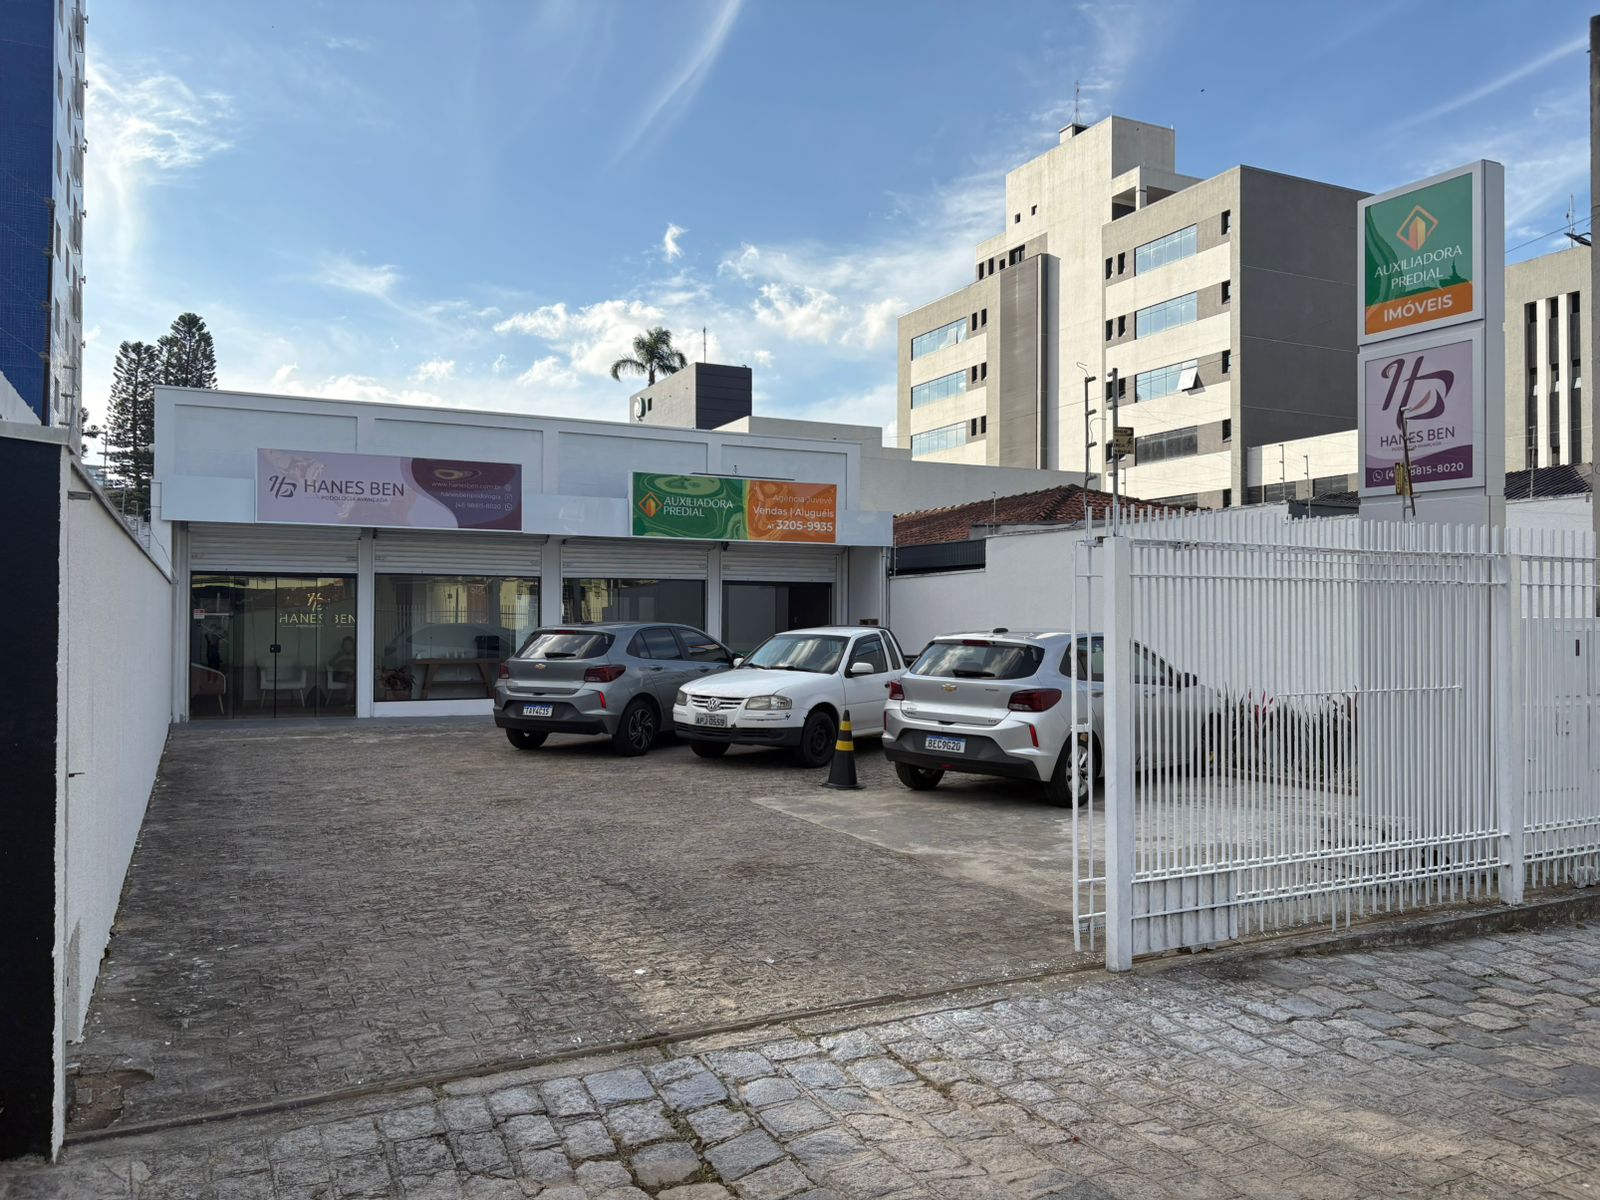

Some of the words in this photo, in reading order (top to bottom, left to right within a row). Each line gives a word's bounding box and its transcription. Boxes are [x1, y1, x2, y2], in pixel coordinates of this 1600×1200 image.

[1374, 244, 1462, 278] AUXILIADORA
[1391, 266, 1444, 289] PREDIAL
[1384, 294, 1453, 322] IMÓVEIS
[1427, 425, 1455, 441] BEN
[304, 479, 365, 495] HANES
[370, 481, 405, 496] BEN
[663, 496, 734, 509] AUXILIADORA
[663, 506, 705, 517] PREDIAL
[753, 505, 788, 516] Vendas
[776, 520, 833, 532] 3205-9935
[928, 739, 961, 751] BEC9G20
